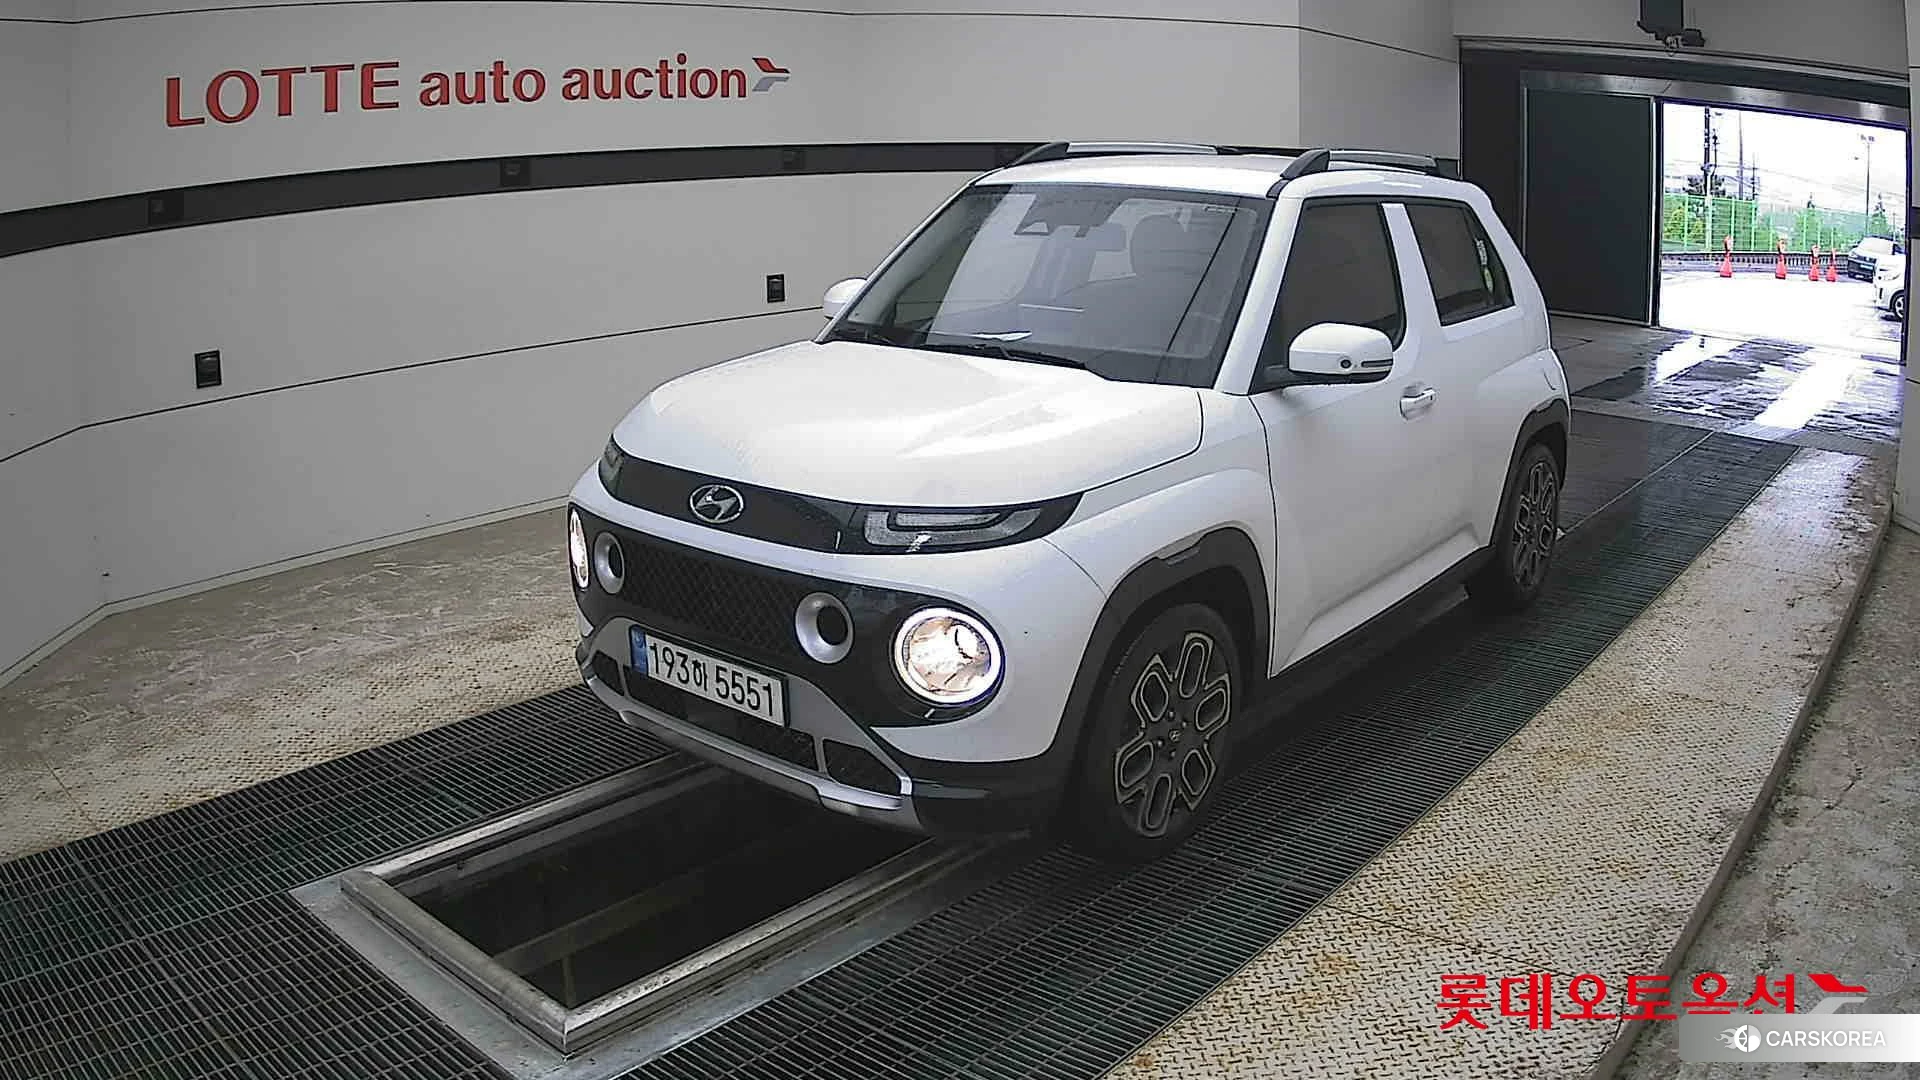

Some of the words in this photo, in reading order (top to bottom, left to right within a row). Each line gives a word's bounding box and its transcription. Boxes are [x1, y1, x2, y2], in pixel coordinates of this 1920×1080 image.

[166, 60, 400, 128] LOTTE
[418, 60, 547, 107] auto
[561, 52, 748, 101] auction
[650, 642, 708, 692] 193하
[715, 664, 773, 717] 5551
